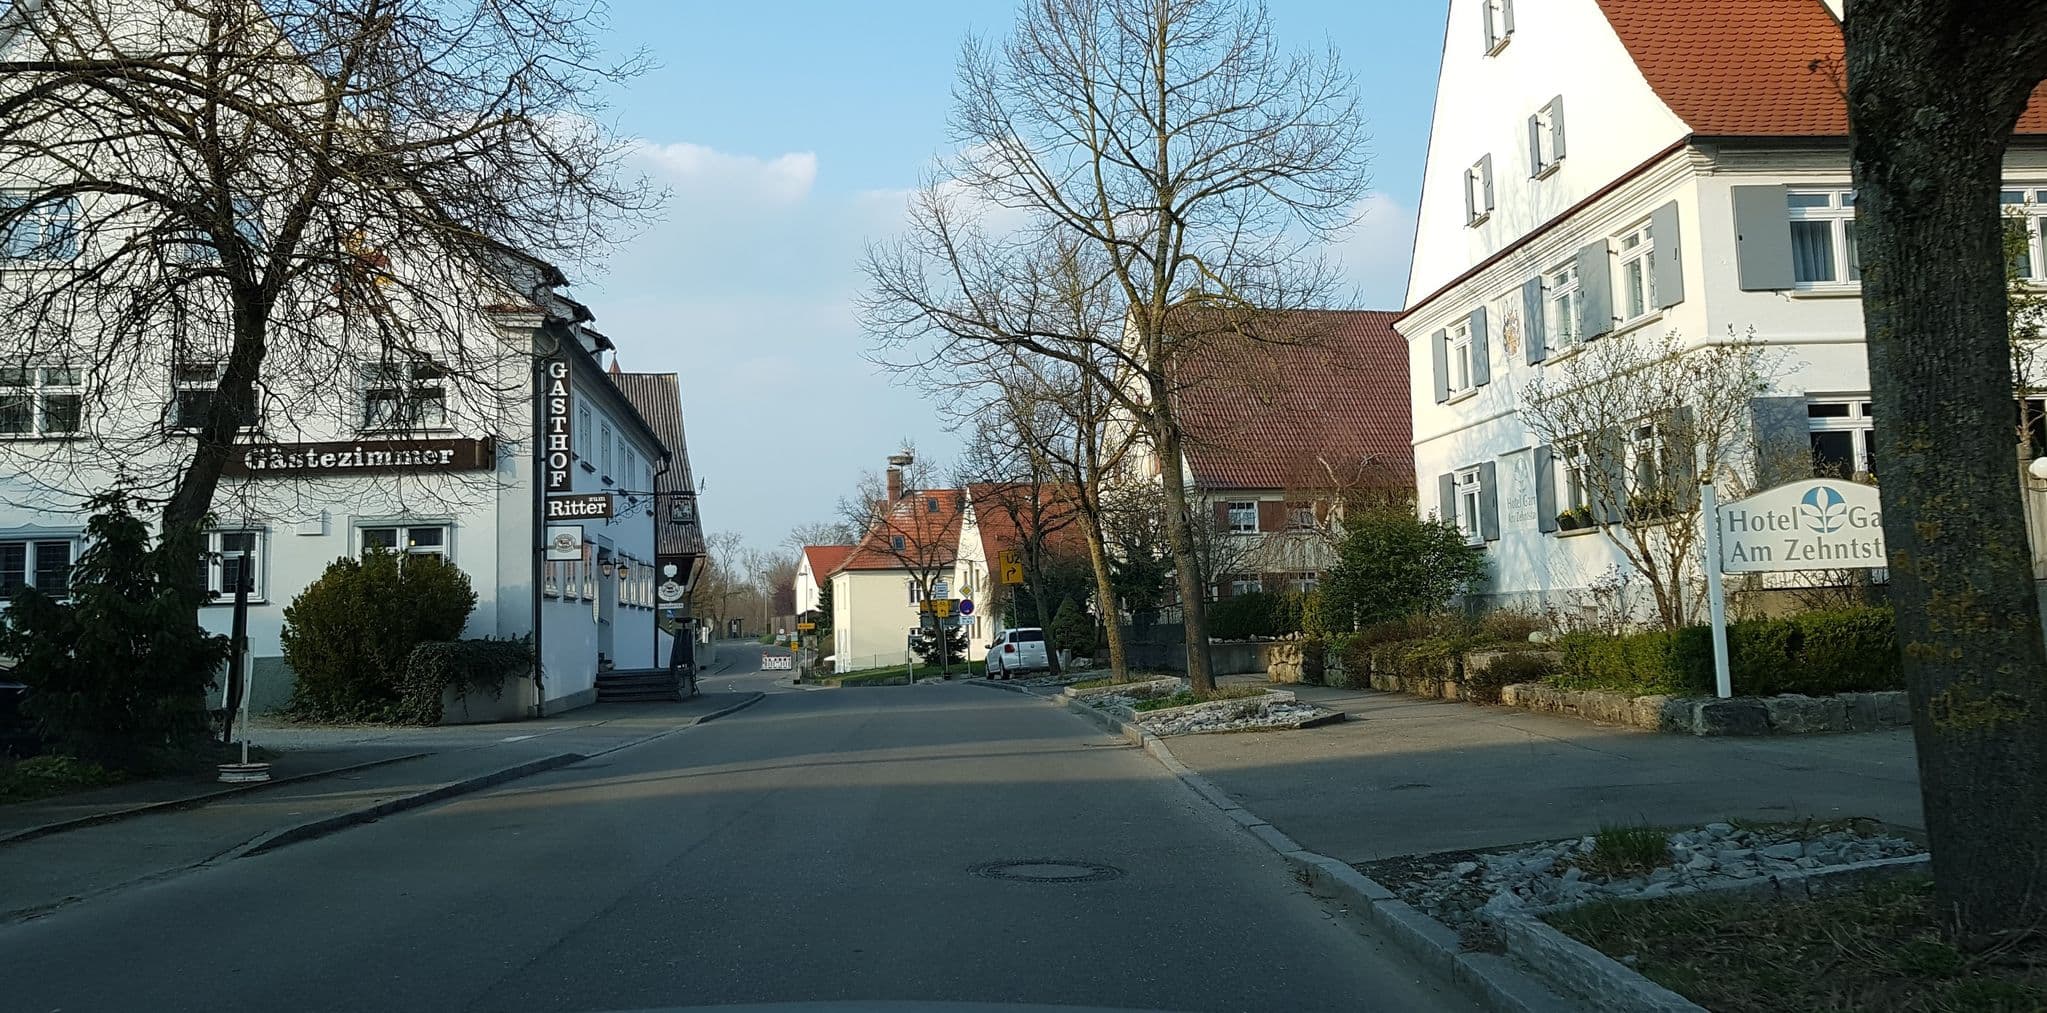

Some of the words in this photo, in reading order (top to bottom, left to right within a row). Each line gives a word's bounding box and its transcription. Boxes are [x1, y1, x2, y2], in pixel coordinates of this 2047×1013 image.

[549, 362, 568, 487] GASTHOF
[244, 446, 455, 470] Gästezimmer
[548, 500, 607, 517] Ritter
[1728, 506, 1799, 532] Hotel
[1731, 540, 1773, 563] Am
[1784, 536, 1883, 561] Zehntst
